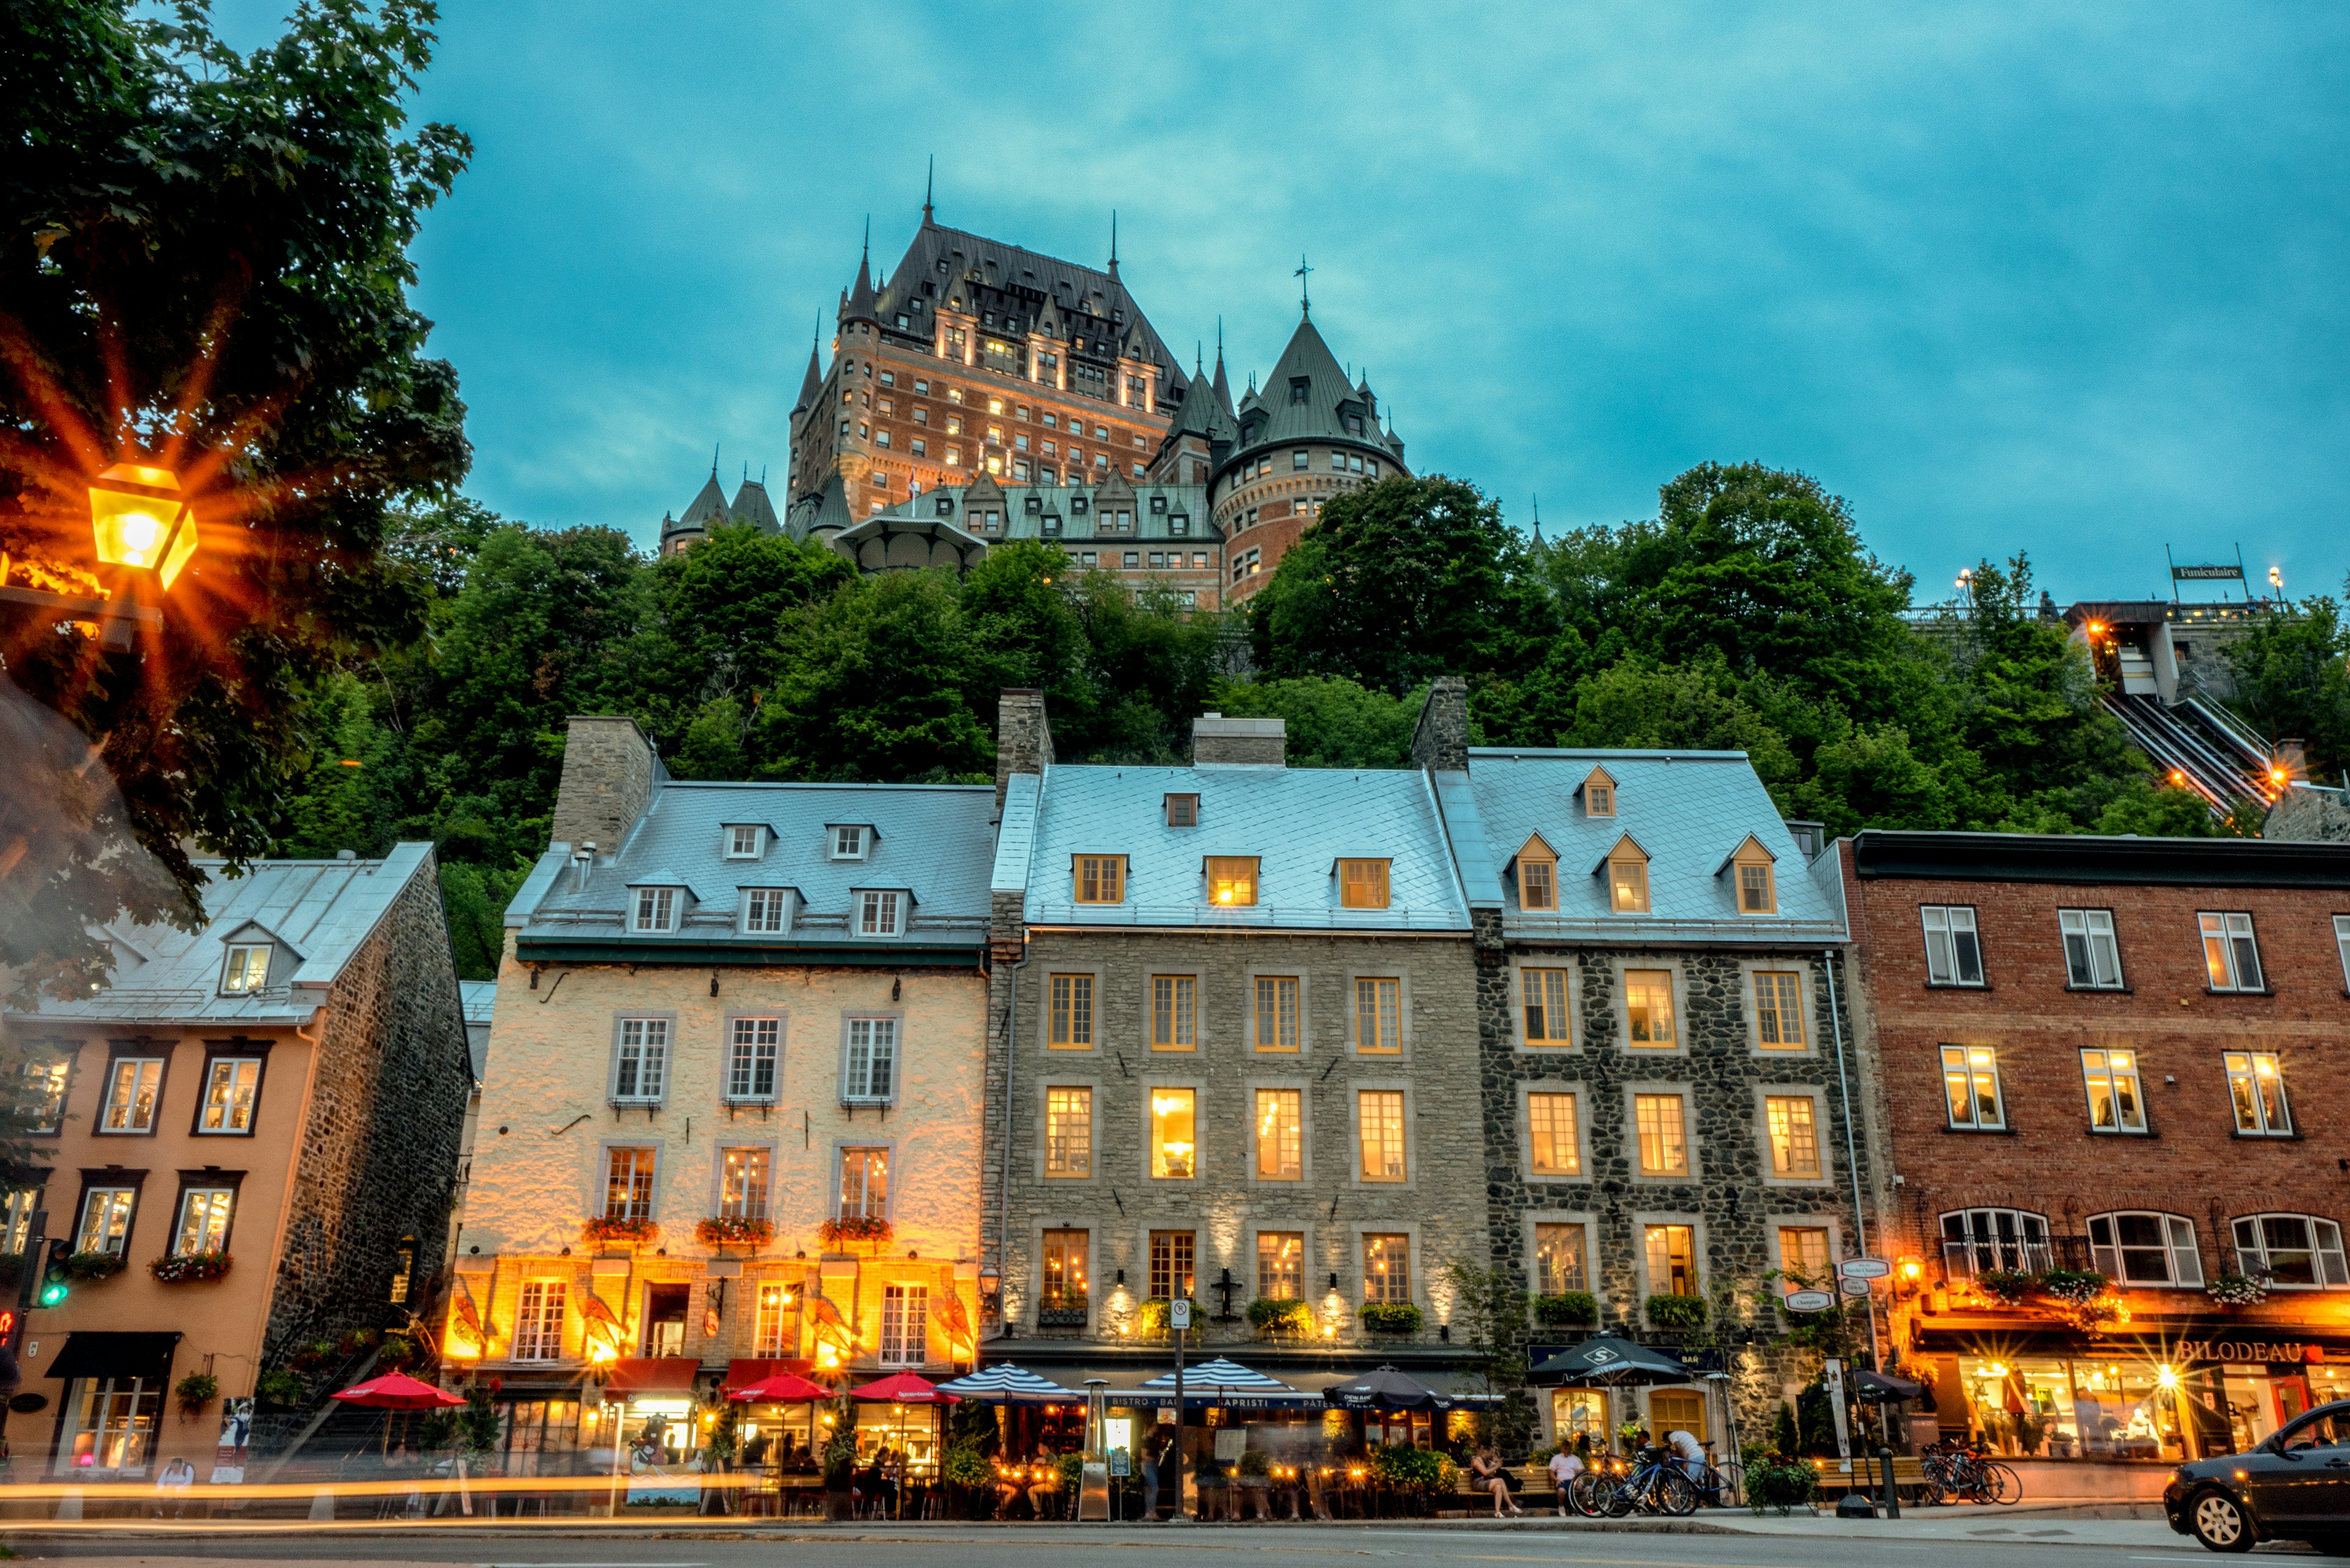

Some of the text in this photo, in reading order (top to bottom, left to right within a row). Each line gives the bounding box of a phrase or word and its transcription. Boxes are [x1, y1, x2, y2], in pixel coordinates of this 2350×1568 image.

[2180, 567, 2238, 577] Funiculaire
[2177, 1340, 2301, 1362] BILODEAU
[1681, 1355, 1699, 1364] BAR
